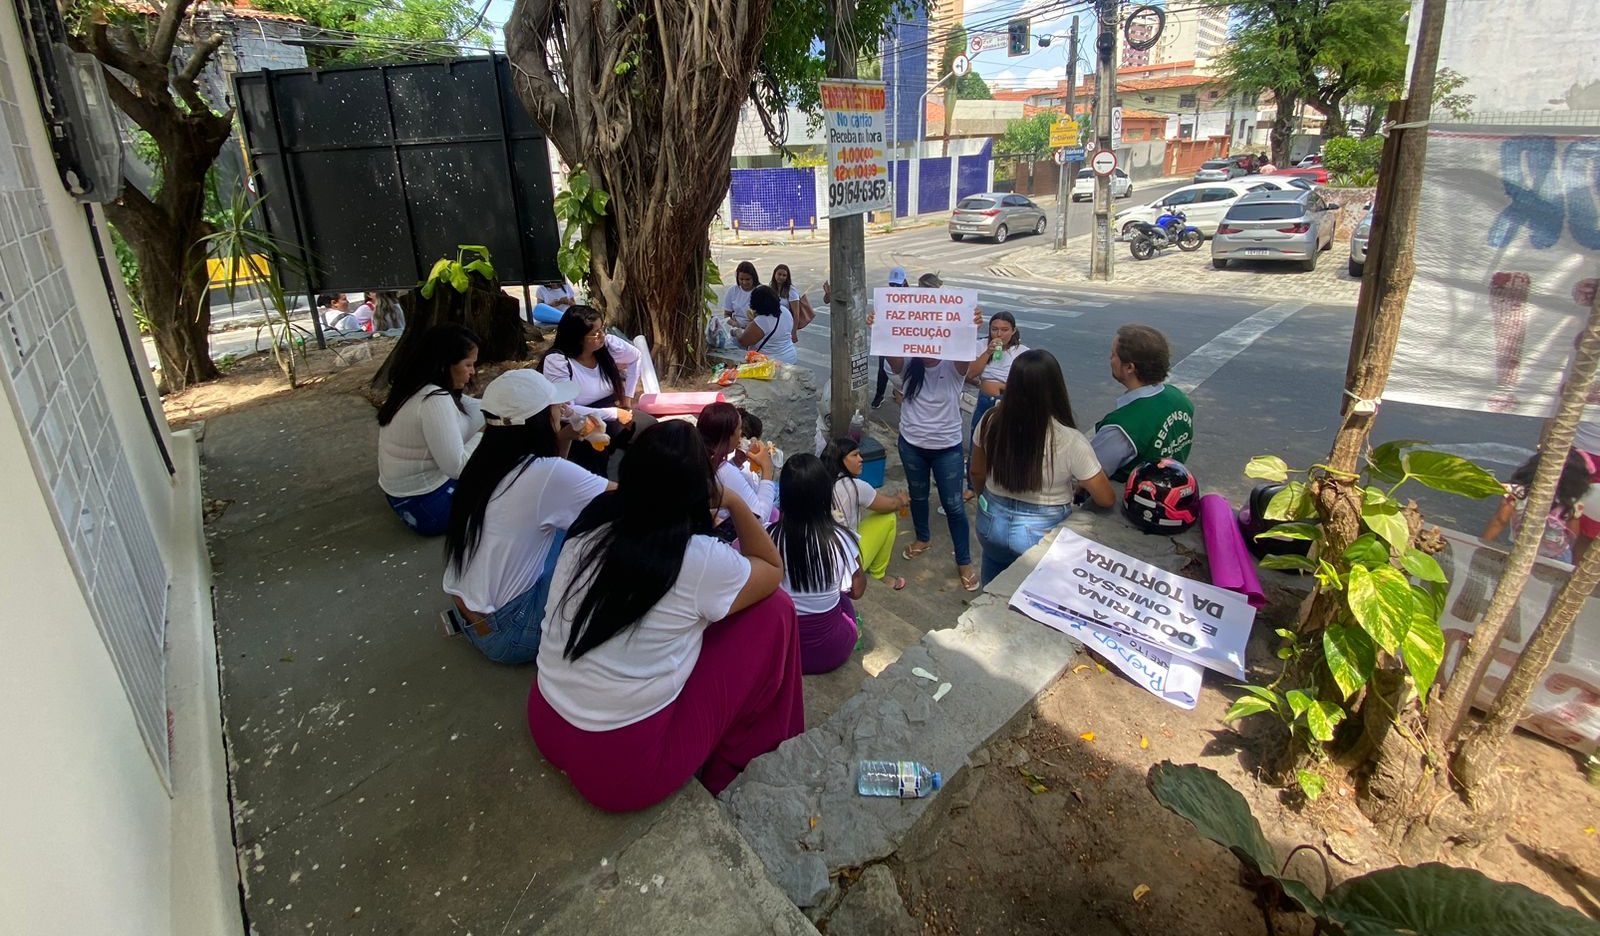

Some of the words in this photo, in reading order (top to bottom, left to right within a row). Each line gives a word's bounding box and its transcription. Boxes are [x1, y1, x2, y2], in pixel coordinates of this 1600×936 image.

[837, 112, 848, 126] No
[830, 128, 857, 144] Receba
[886, 293, 937, 304] TORTURA
[886, 310, 905, 320] FAZ
[908, 311, 943, 321] PARTE
[946, 312, 961, 322] DA
[892, 326, 951, 340] EXECUÇÃO
[903, 344, 942, 355] PENAL!
[1086, 549, 1184, 603] TORTURA
[1072, 567, 1171, 616] OMISSÃO
[1192, 593, 1225, 619] DA
[1078, 583, 1197, 646] DOUTRINA
[1179, 612, 1197, 625] A
[1201, 622, 1219, 637] E
